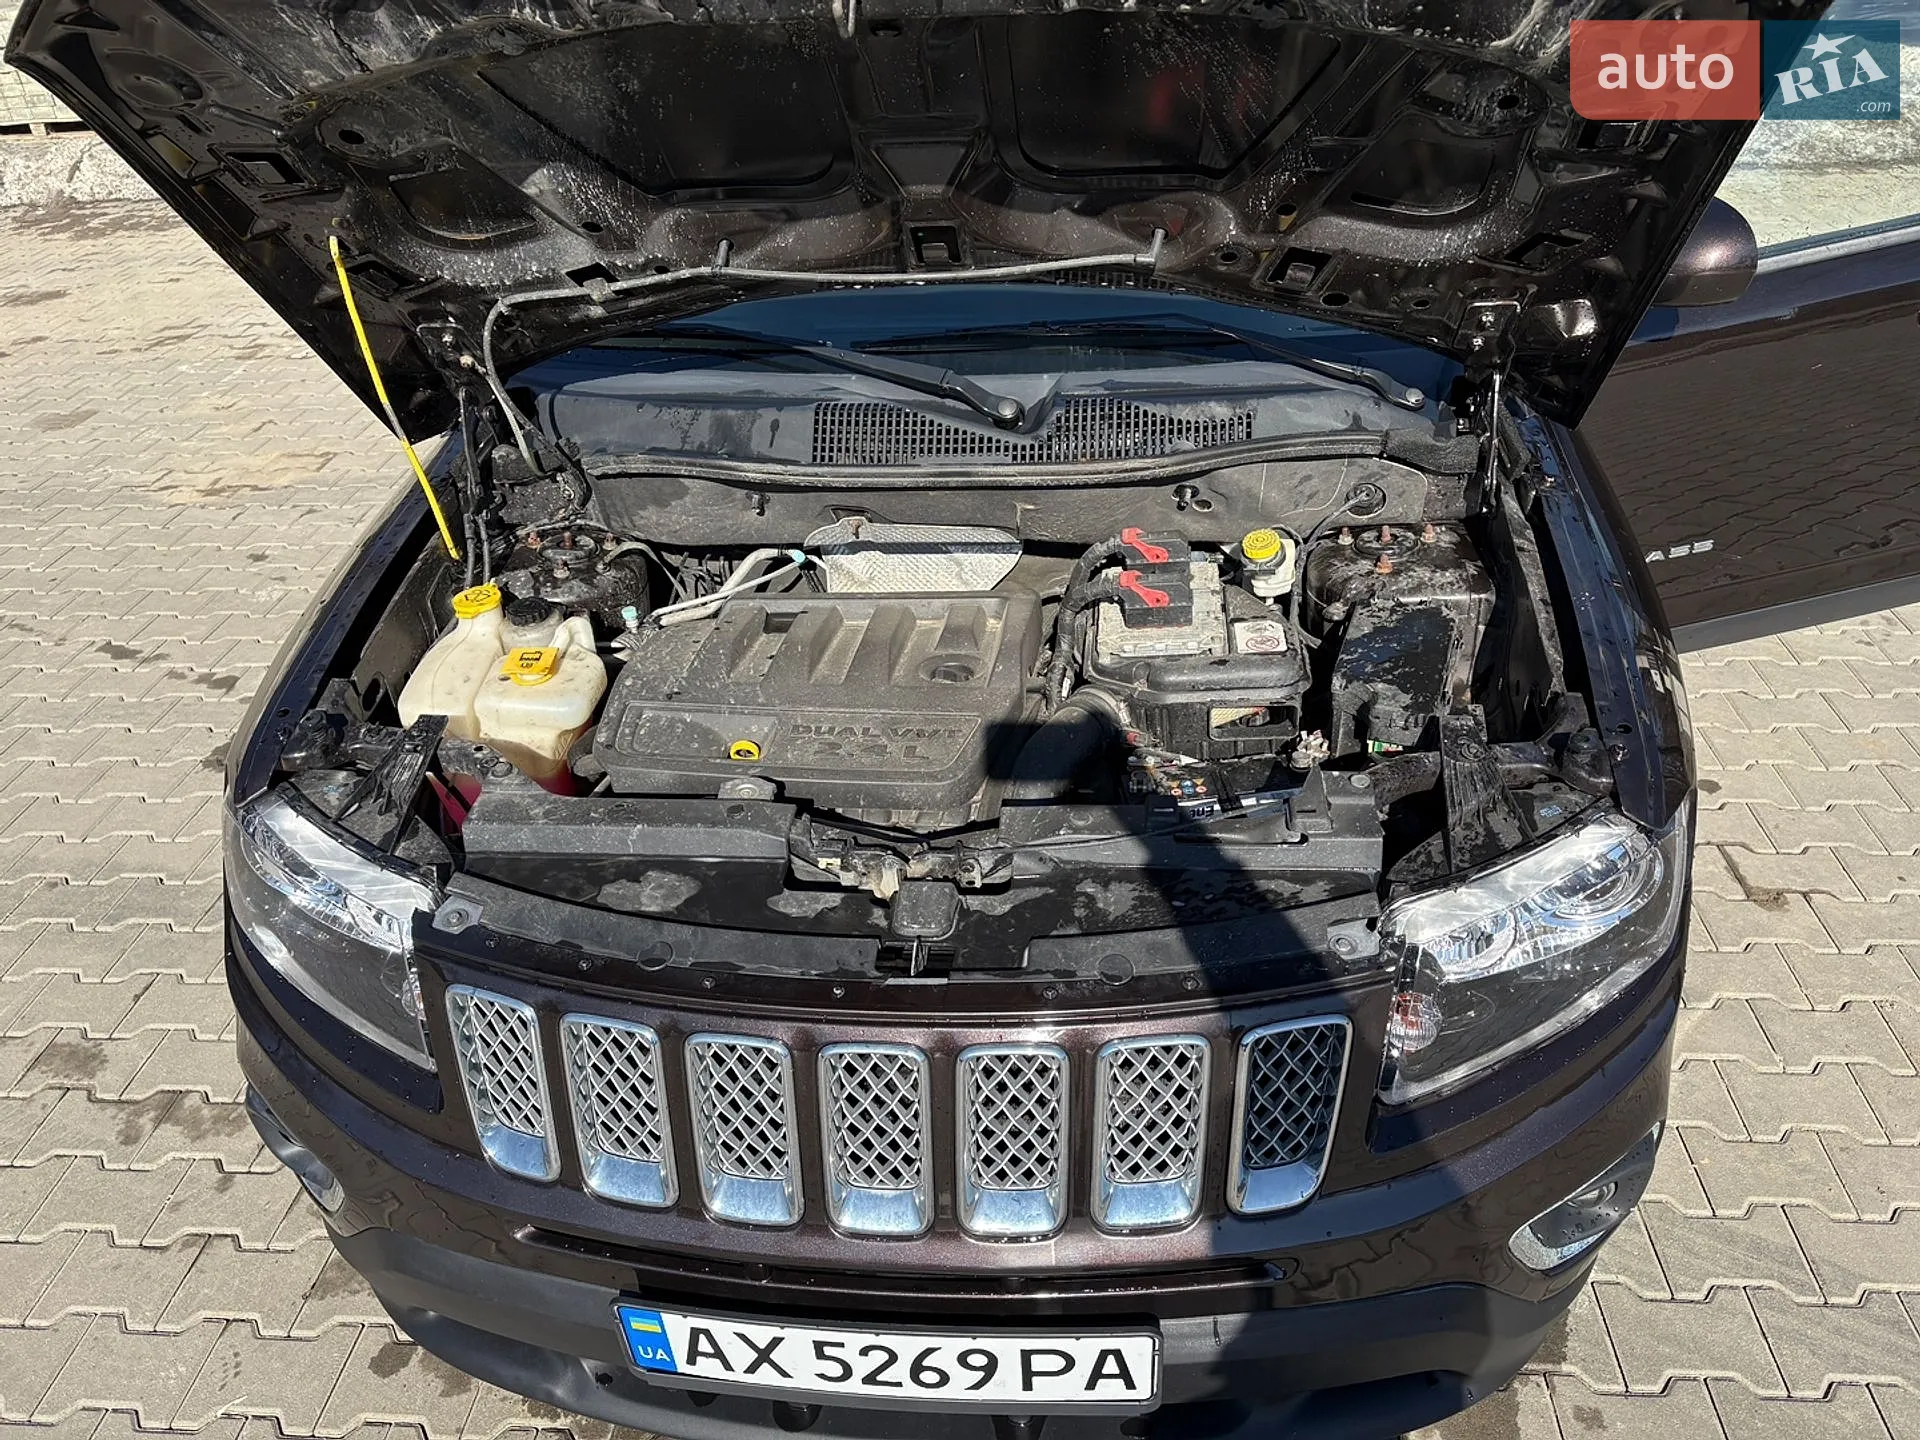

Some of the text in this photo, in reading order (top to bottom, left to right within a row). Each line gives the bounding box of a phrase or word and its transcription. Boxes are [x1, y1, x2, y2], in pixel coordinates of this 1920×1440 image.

[1645, 540, 1714, 563] ASS
[790, 724, 882, 739] DUAL
[638, 1345, 670, 1362] UA
[686, 1326, 1137, 1391] AX 5269 PA
